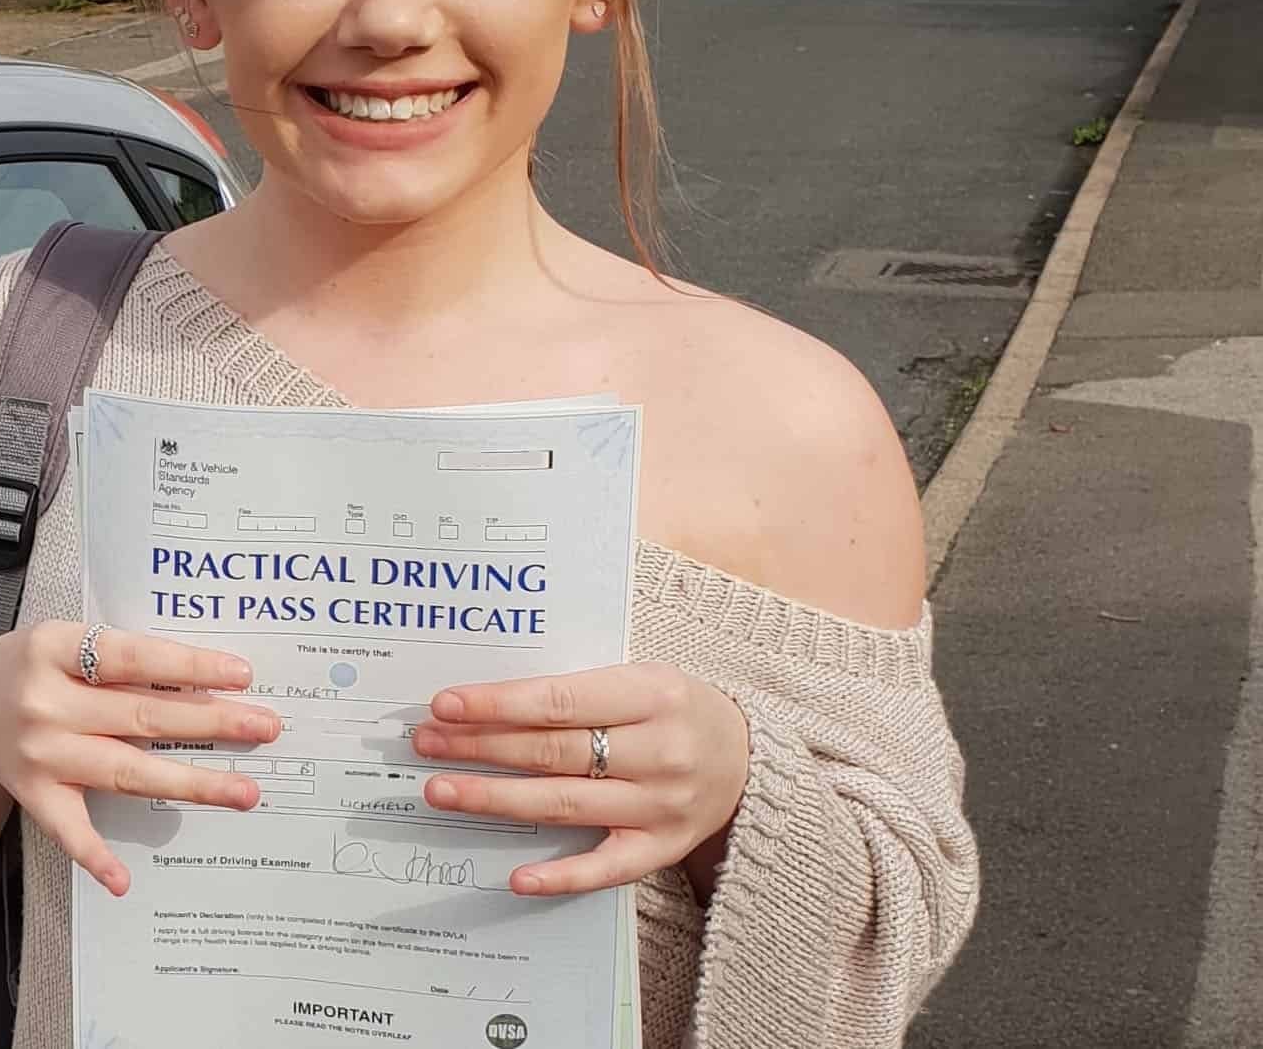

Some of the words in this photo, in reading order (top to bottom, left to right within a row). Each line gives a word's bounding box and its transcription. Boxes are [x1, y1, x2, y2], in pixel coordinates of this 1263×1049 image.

[159, 458, 187, 471] Driver
[190, 462, 198, 471] &
[201, 462, 238, 475] Vehicle
[158, 470, 210, 485] Standards
[158, 483, 195, 498] Agency
[152, 547, 355, 583] PRACTICAL
[371, 558, 545, 592] DRIVING
[151, 591, 225, 619] TEST
[238, 596, 315, 622] PASS
[328, 598, 545, 634] CERTIFICATE
[297, 645, 316, 653] This
[341, 648, 370, 657] certify
[151, 682, 181, 693] Name
[287, 685, 341, 698] PAGETT
[151, 741, 172, 750] Has
[175, 741, 214, 751] Passed
[340, 798, 416, 811] LICHFIELD
[153, 854, 203, 865] Signature
[206, 856, 216, 864] of
[220, 856, 258, 867] Driving
[261, 857, 312, 868] Examiner
[293, 1001, 394, 1026] IMPORTANT
[274, 1018, 304, 1027] PLEASE
[306, 1021, 327, 1030] READ
[328, 1024, 342, 1032] THE
[344, 1027, 370, 1036] NOTES
[371, 1030, 412, 1040] OVERLEAF
